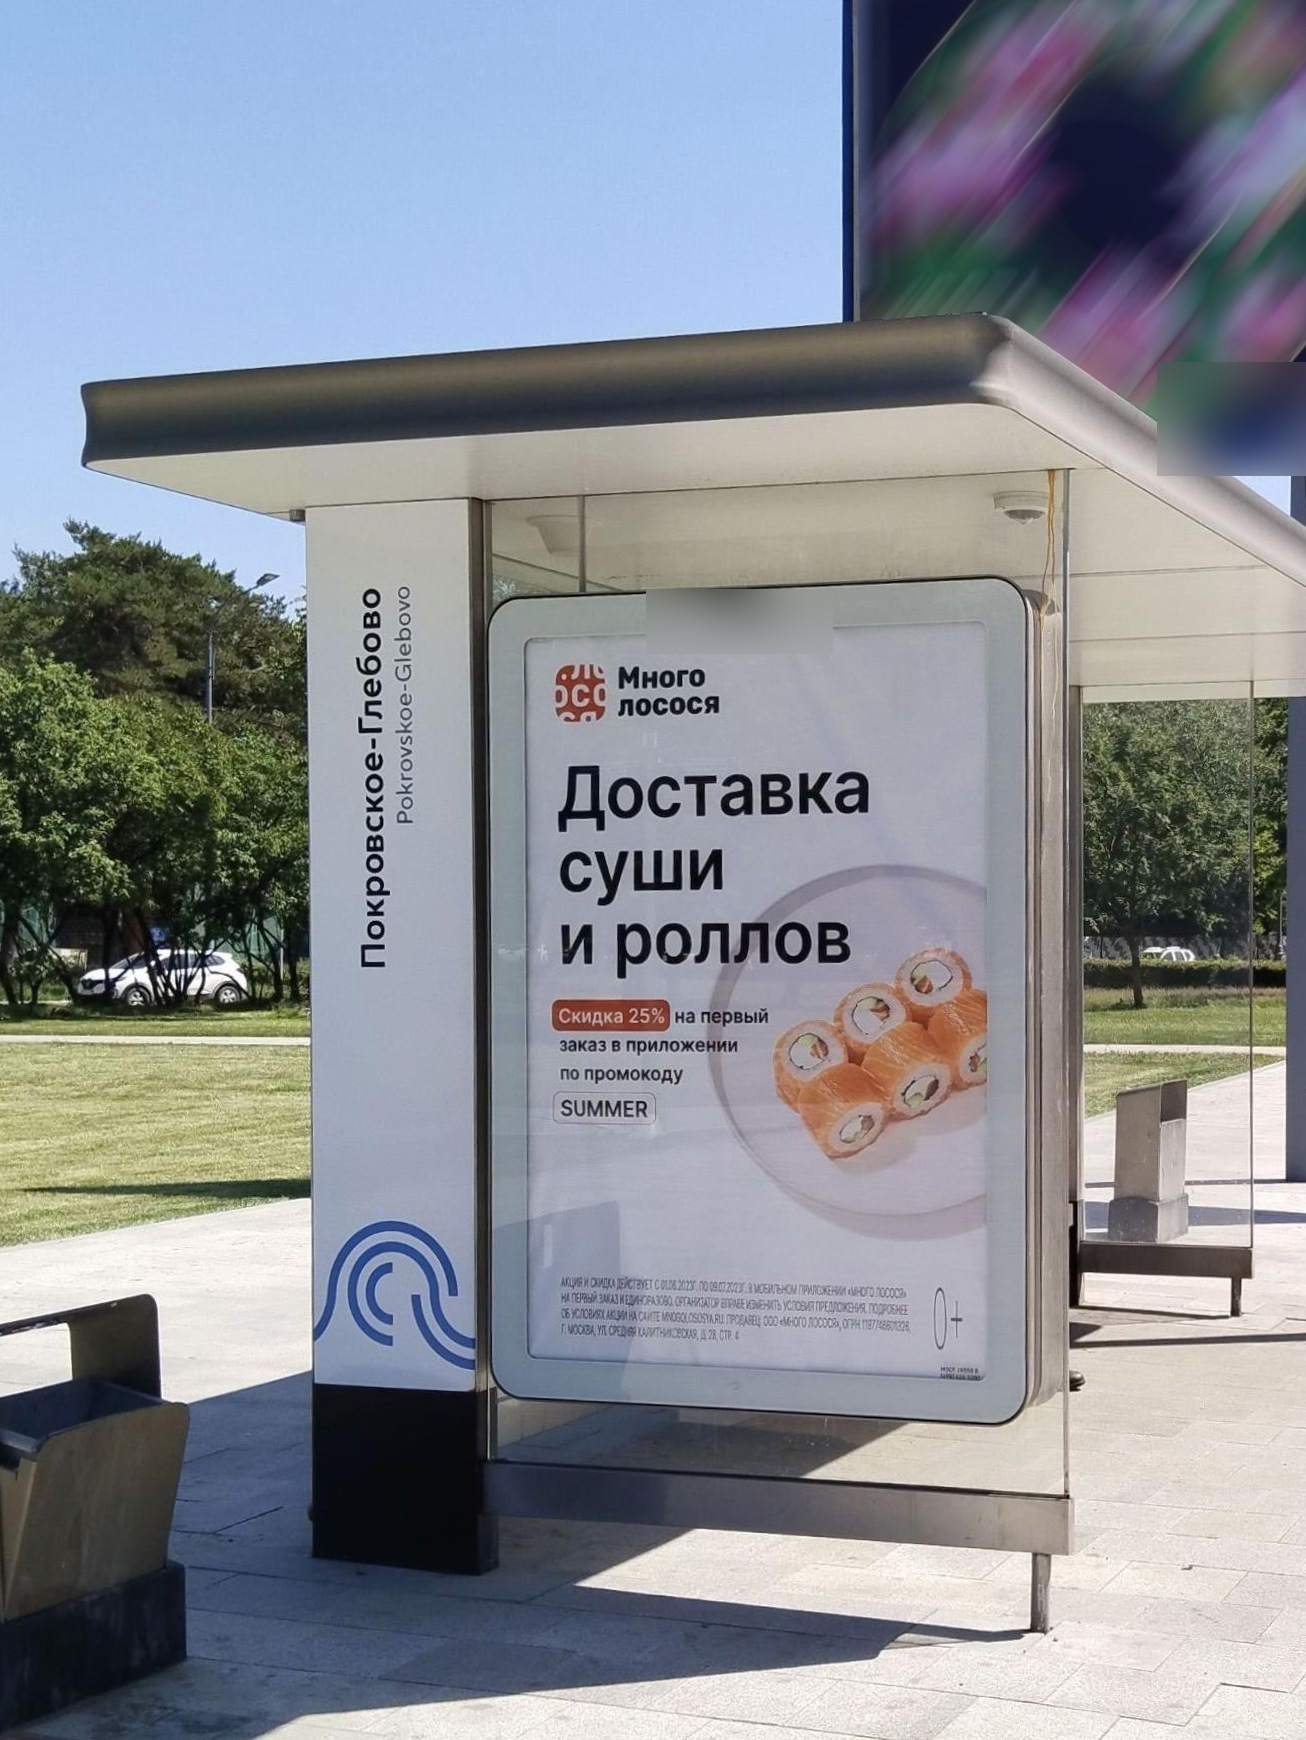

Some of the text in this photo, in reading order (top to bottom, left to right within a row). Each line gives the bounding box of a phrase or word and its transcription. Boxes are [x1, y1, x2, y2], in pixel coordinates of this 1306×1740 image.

[617, 665, 706, 690] Много
[394, 586, 414, 824] Pokrovskoe-Glebovo
[617, 695, 720, 718] лосося
[356, 588, 390, 967] Покровское-Глебово
[557, 765, 871, 832] Доставка
[559, 848, 724, 907] суши
[560, 921, 852, 979] и роллов
[558, 1007, 769, 1029] Скидка 25% на первый
[559, 1039, 739, 1056] заказ в приложении
[560, 1068, 684, 1085] по промокоду
[560, 1099, 649, 1119] SUMMER
